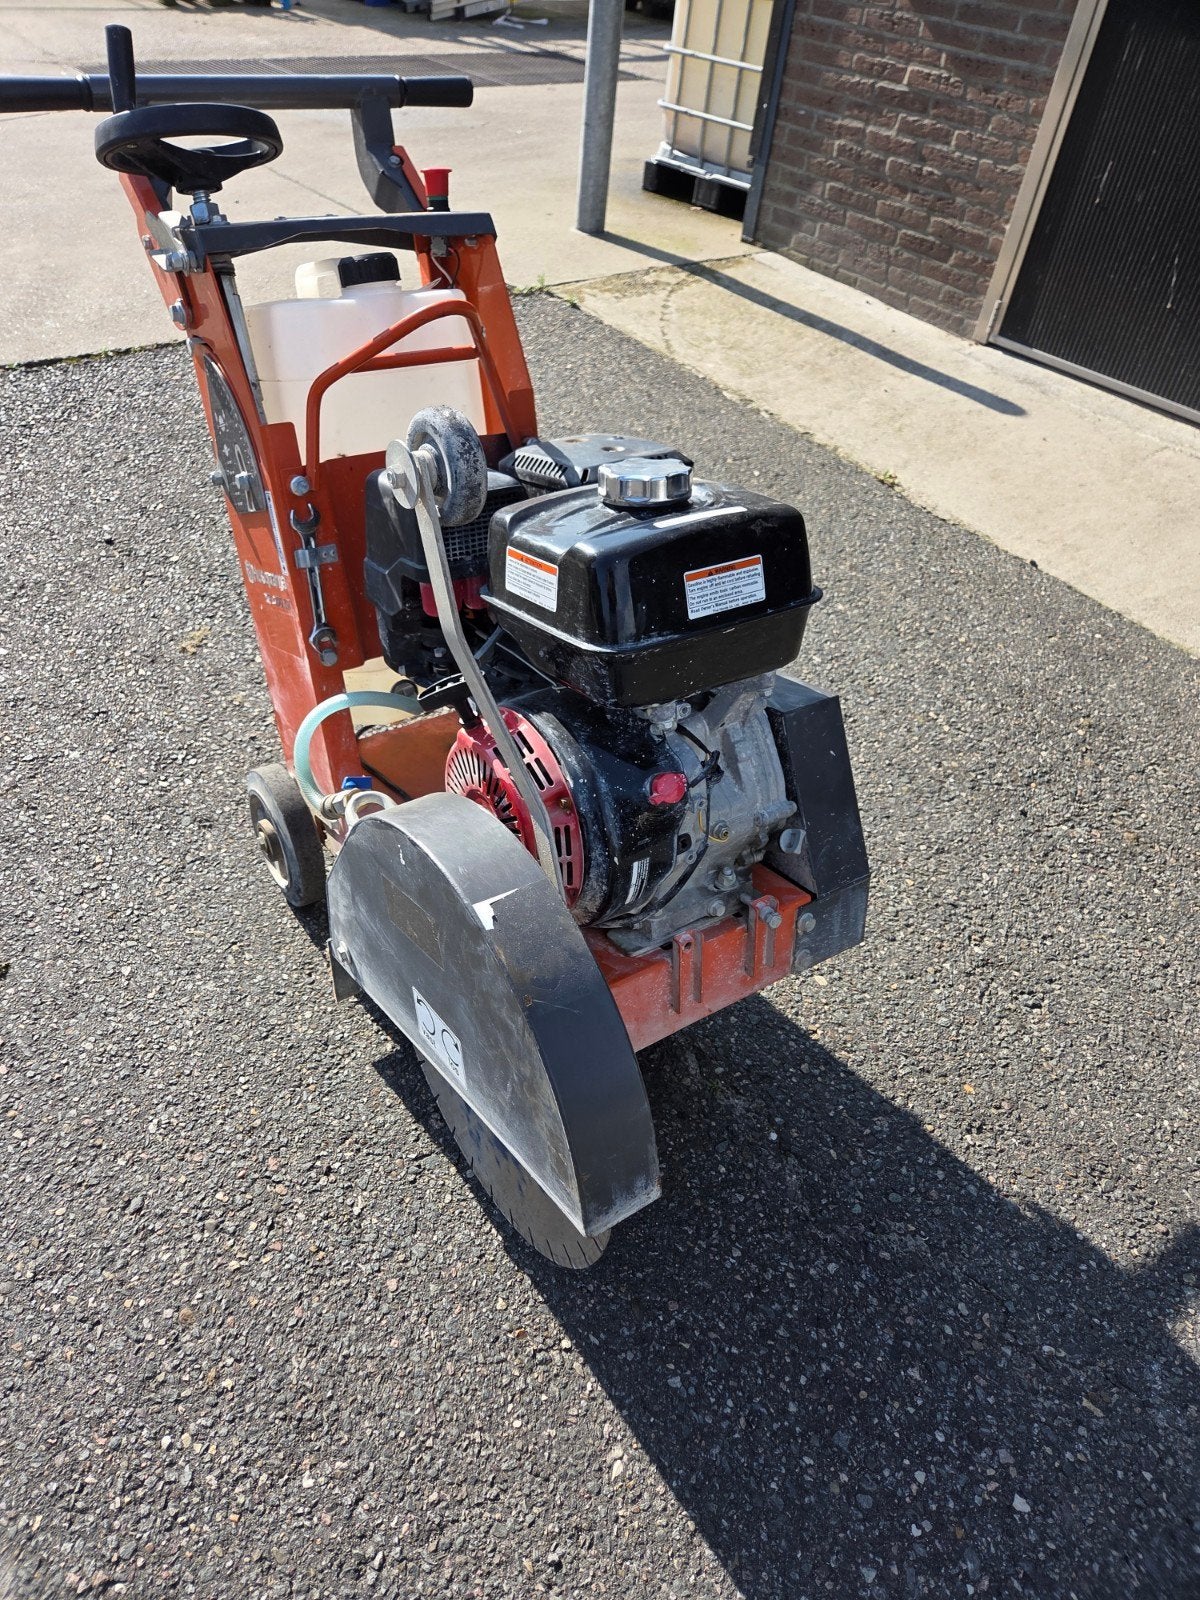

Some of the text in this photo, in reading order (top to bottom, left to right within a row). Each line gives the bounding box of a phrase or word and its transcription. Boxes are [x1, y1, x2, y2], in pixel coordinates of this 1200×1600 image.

[715, 564, 736, 574] WARNING
[717, 572, 735, 581] flammable
[697, 585, 708, 593] engine
[735, 574, 745, 582] before
[697, 592, 709, 600] engine
[718, 592, 734, 600] enclosed
